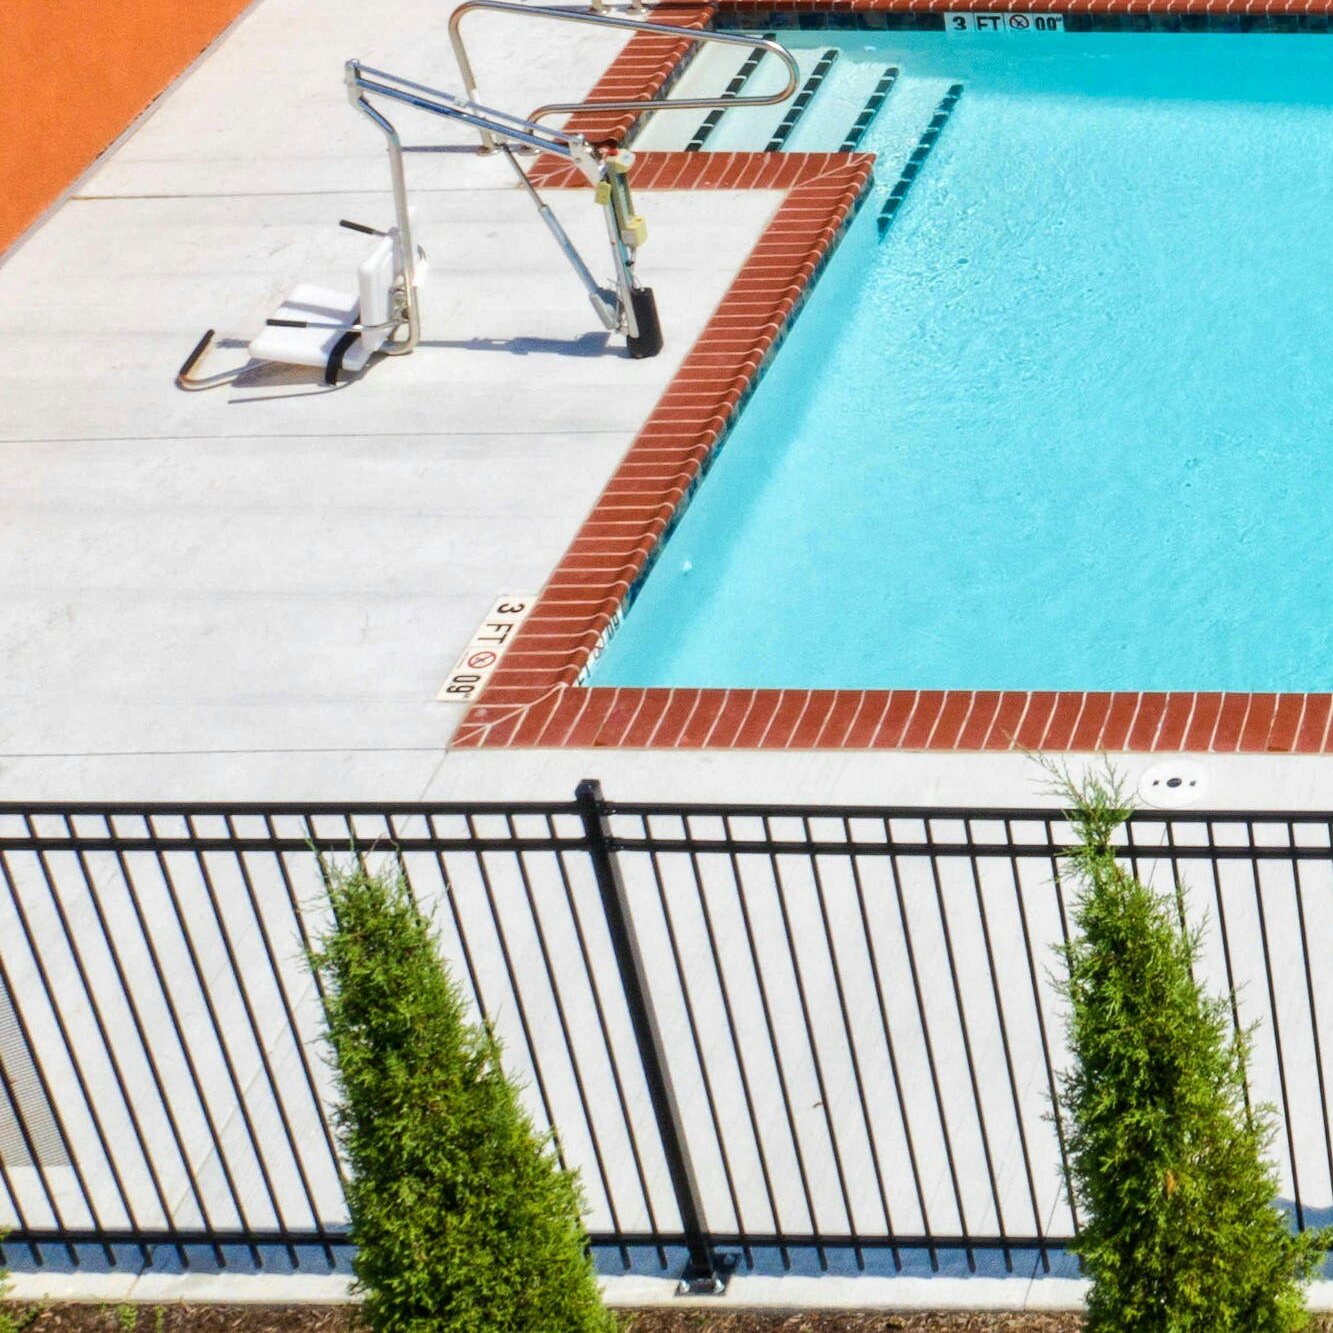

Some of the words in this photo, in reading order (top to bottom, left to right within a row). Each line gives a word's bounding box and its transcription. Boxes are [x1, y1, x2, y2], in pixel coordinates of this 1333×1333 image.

[951, 15, 968, 31] 3
[975, 15, 1001, 31] FT
[496, 603, 526, 614] 3
[477, 623, 514, 644] FT
